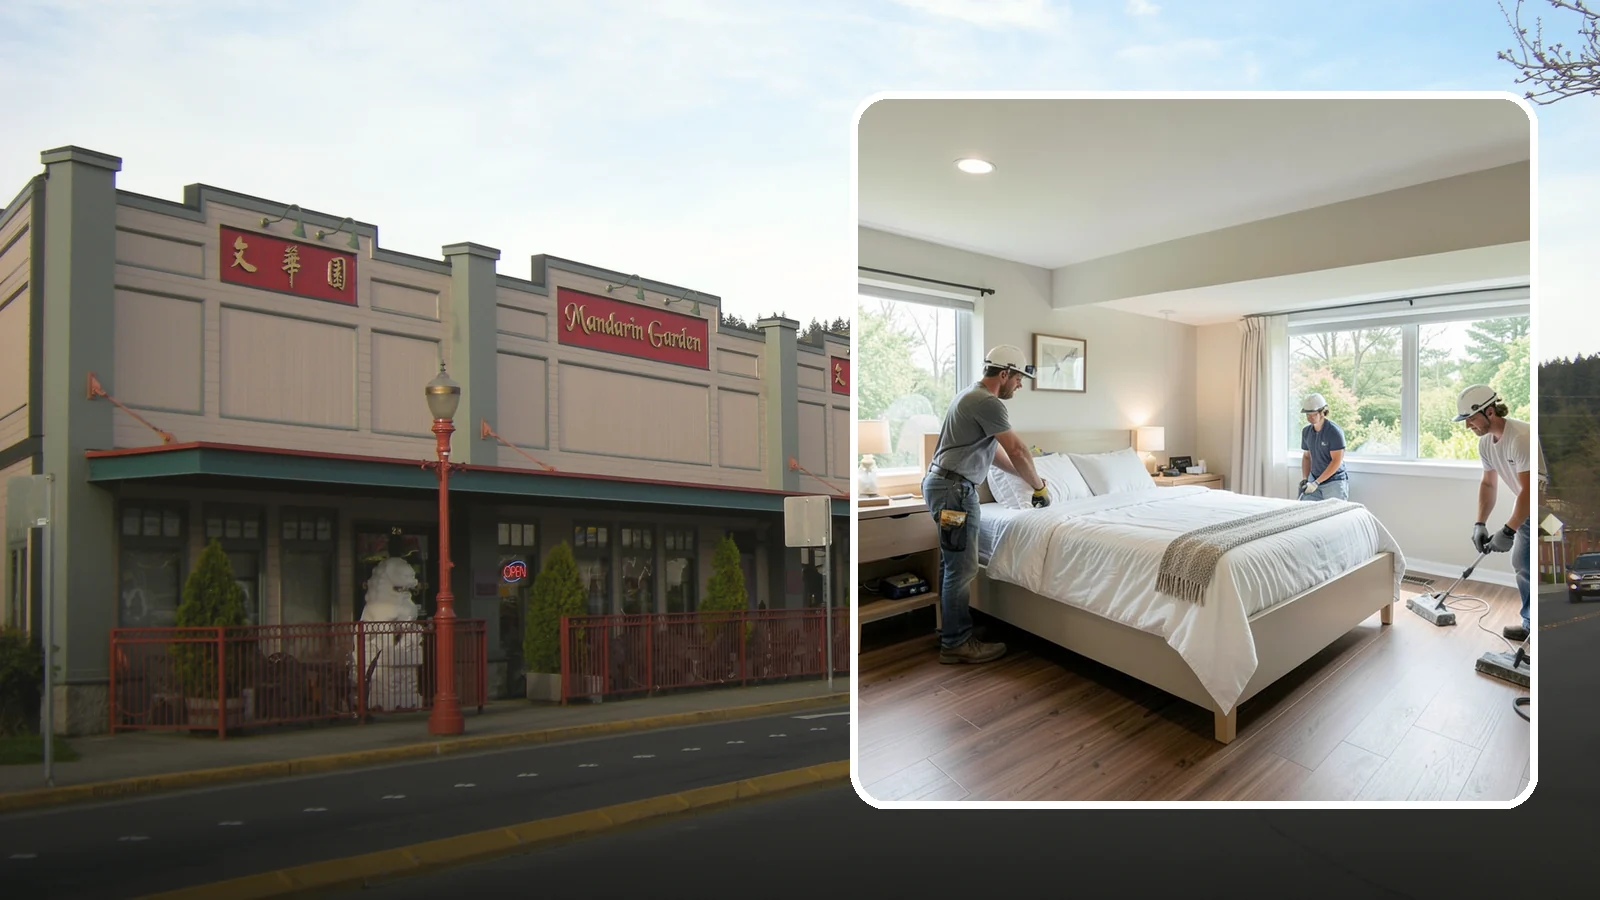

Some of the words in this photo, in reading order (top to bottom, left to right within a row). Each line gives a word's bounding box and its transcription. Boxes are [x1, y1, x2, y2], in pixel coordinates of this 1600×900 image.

[565, 303, 643, 340] Mandarin
[648, 320, 701, 352] Garden
[503, 565, 527, 578] OPEN
